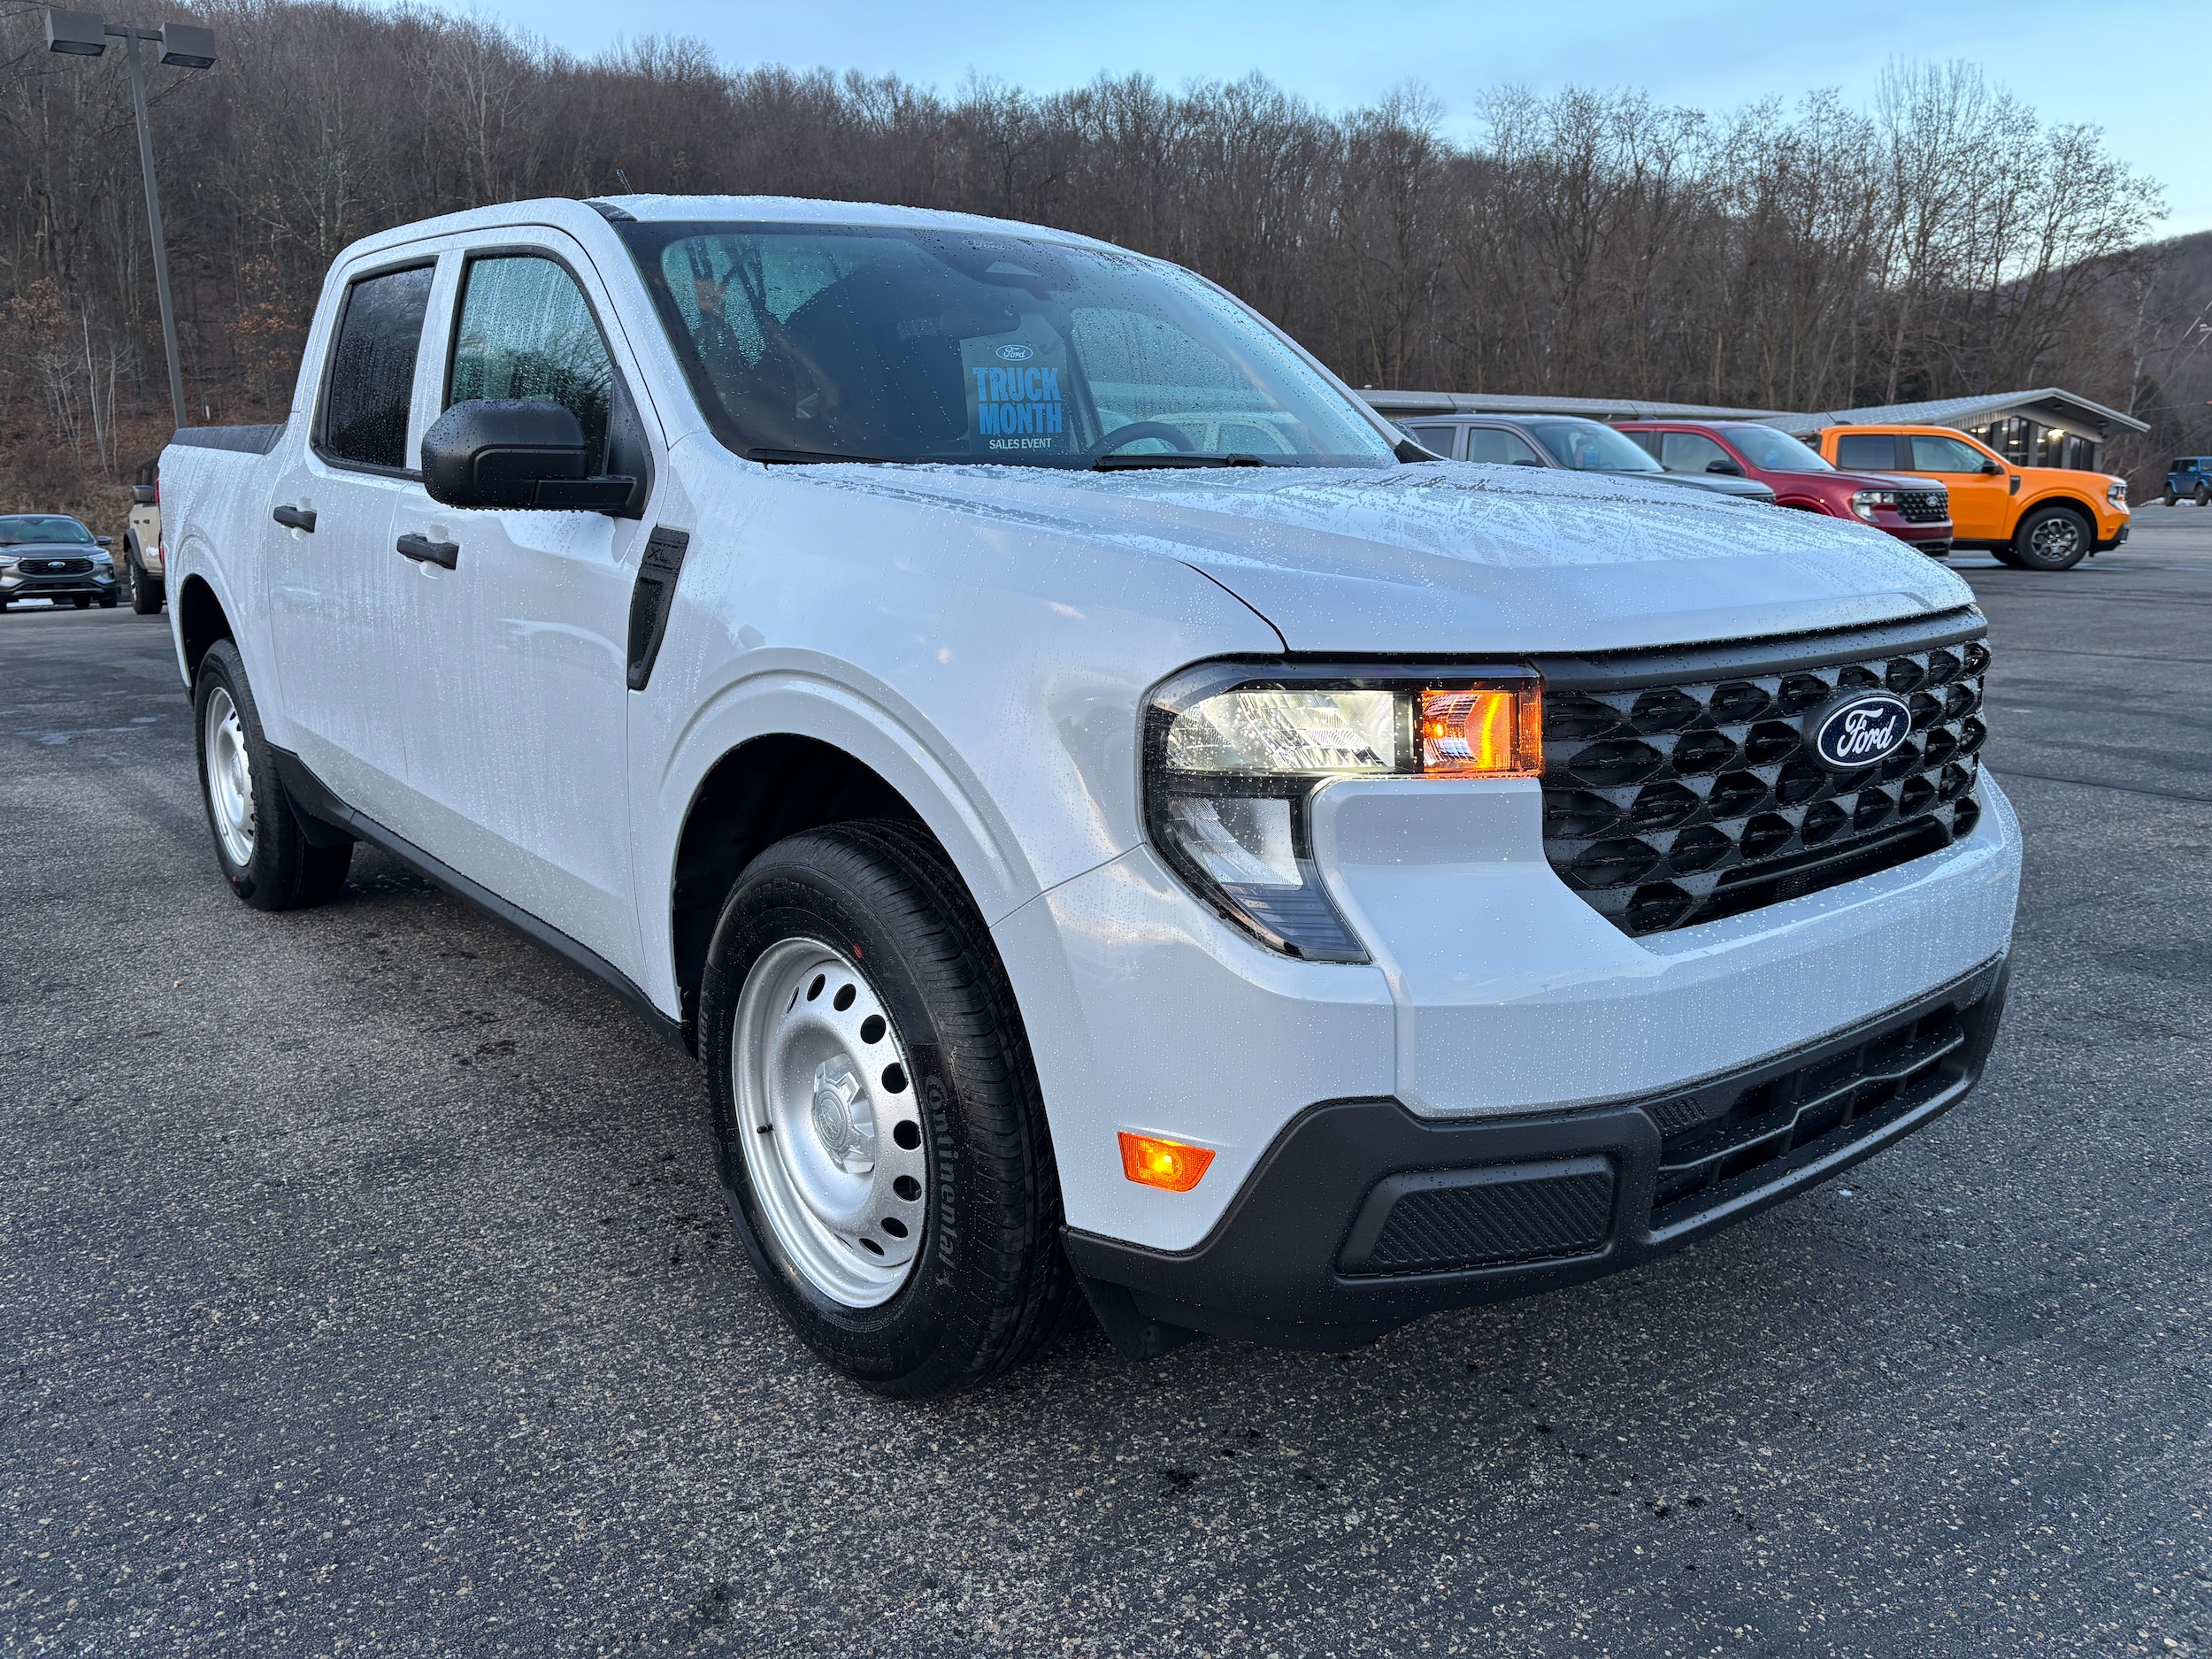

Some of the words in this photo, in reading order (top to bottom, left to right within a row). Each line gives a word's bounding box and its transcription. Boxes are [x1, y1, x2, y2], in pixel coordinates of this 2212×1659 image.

[1003, 347, 1025, 358] Ford
[972, 367, 1062, 401] TRUCK
[979, 403, 1062, 434] MONTH
[989, 439, 1020, 449] SALES
[1022, 438, 1052, 449] EVENT
[1837, 708, 1896, 757] Ford
[925, 1074, 959, 1270] Continental
